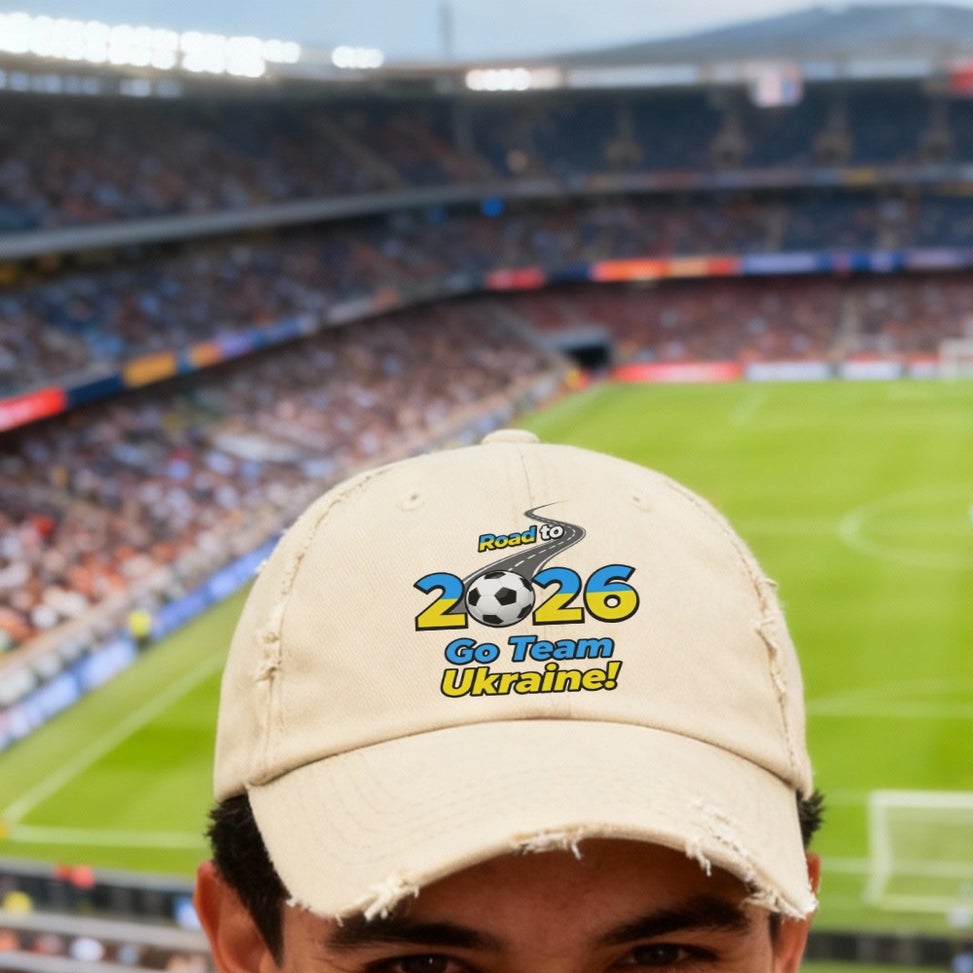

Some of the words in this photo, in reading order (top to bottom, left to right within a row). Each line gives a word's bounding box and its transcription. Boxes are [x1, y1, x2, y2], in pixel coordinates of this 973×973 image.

[478, 525, 537, 553] Road
[540, 524, 564, 541] to
[444, 637, 500, 665] Go
[508, 635, 615, 662] Team
[440, 660, 623, 698] Ukraine!
